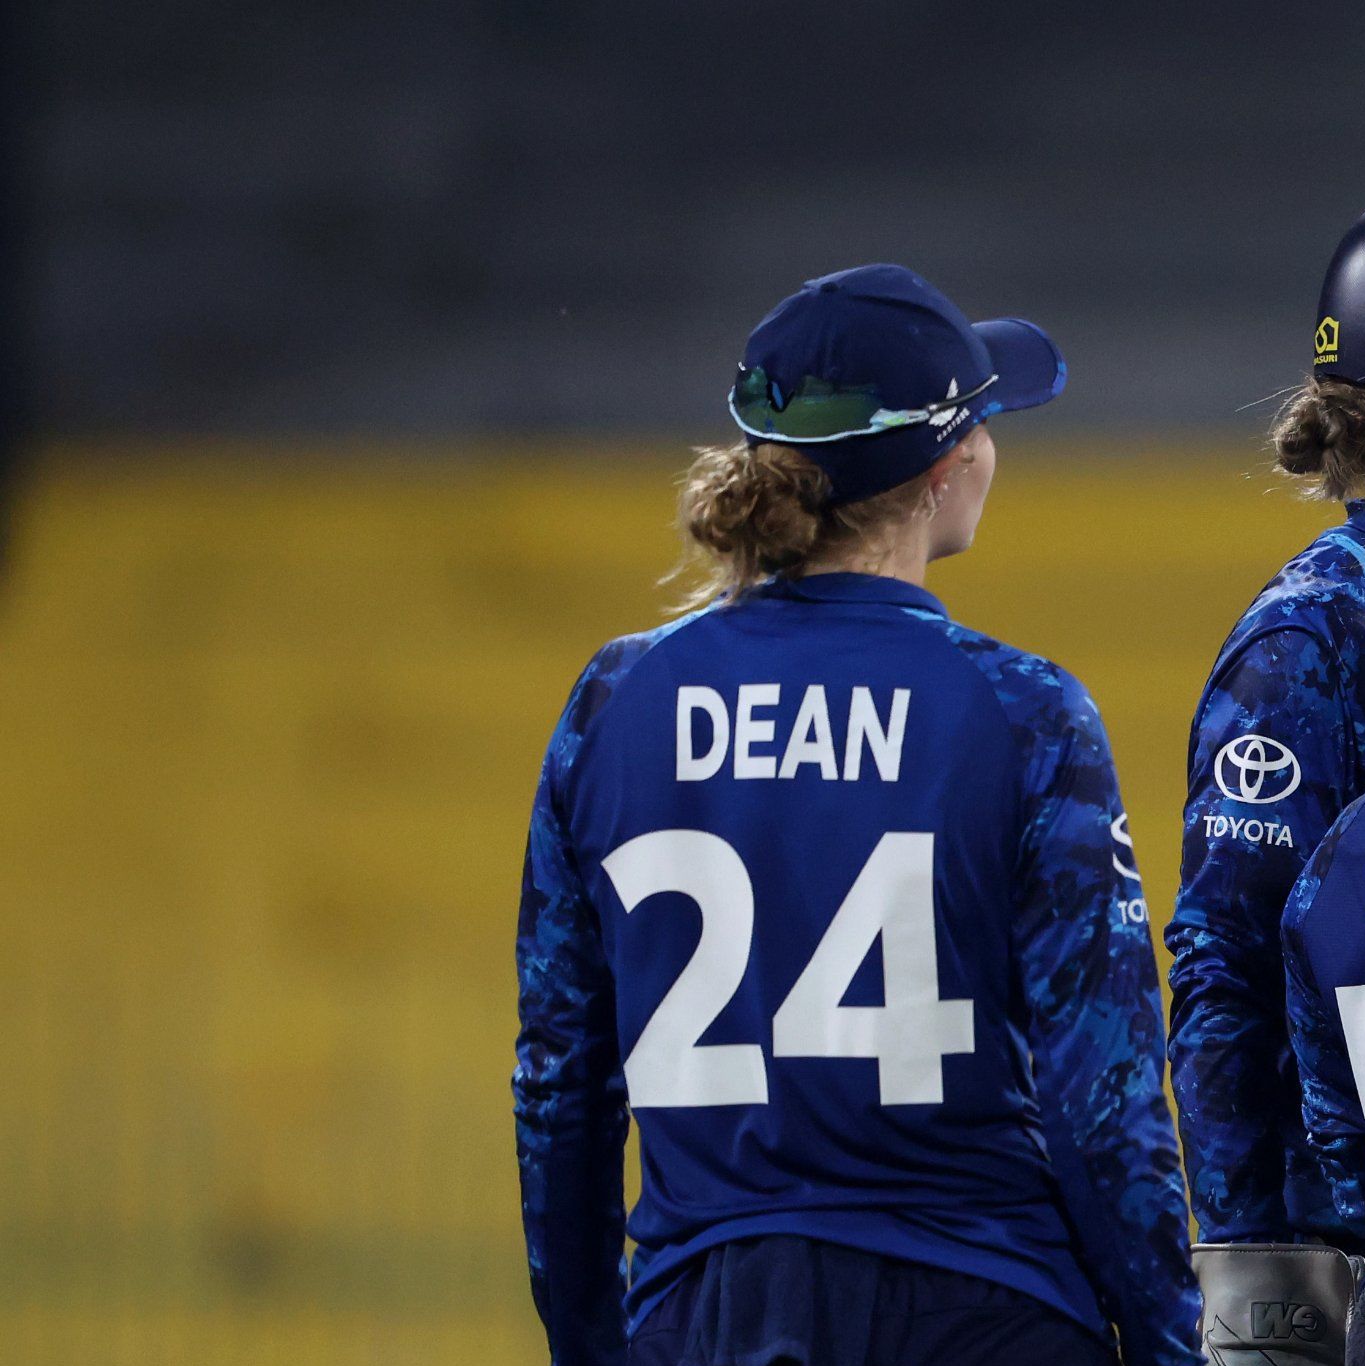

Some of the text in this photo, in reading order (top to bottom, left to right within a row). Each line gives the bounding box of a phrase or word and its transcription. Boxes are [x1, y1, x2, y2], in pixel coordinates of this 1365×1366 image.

[676, 683, 911, 782] DEAN
[1203, 815, 1294, 848] TOYOTA
[601, 829, 975, 1108] 24
[1250, 1300, 1328, 1342] GM
